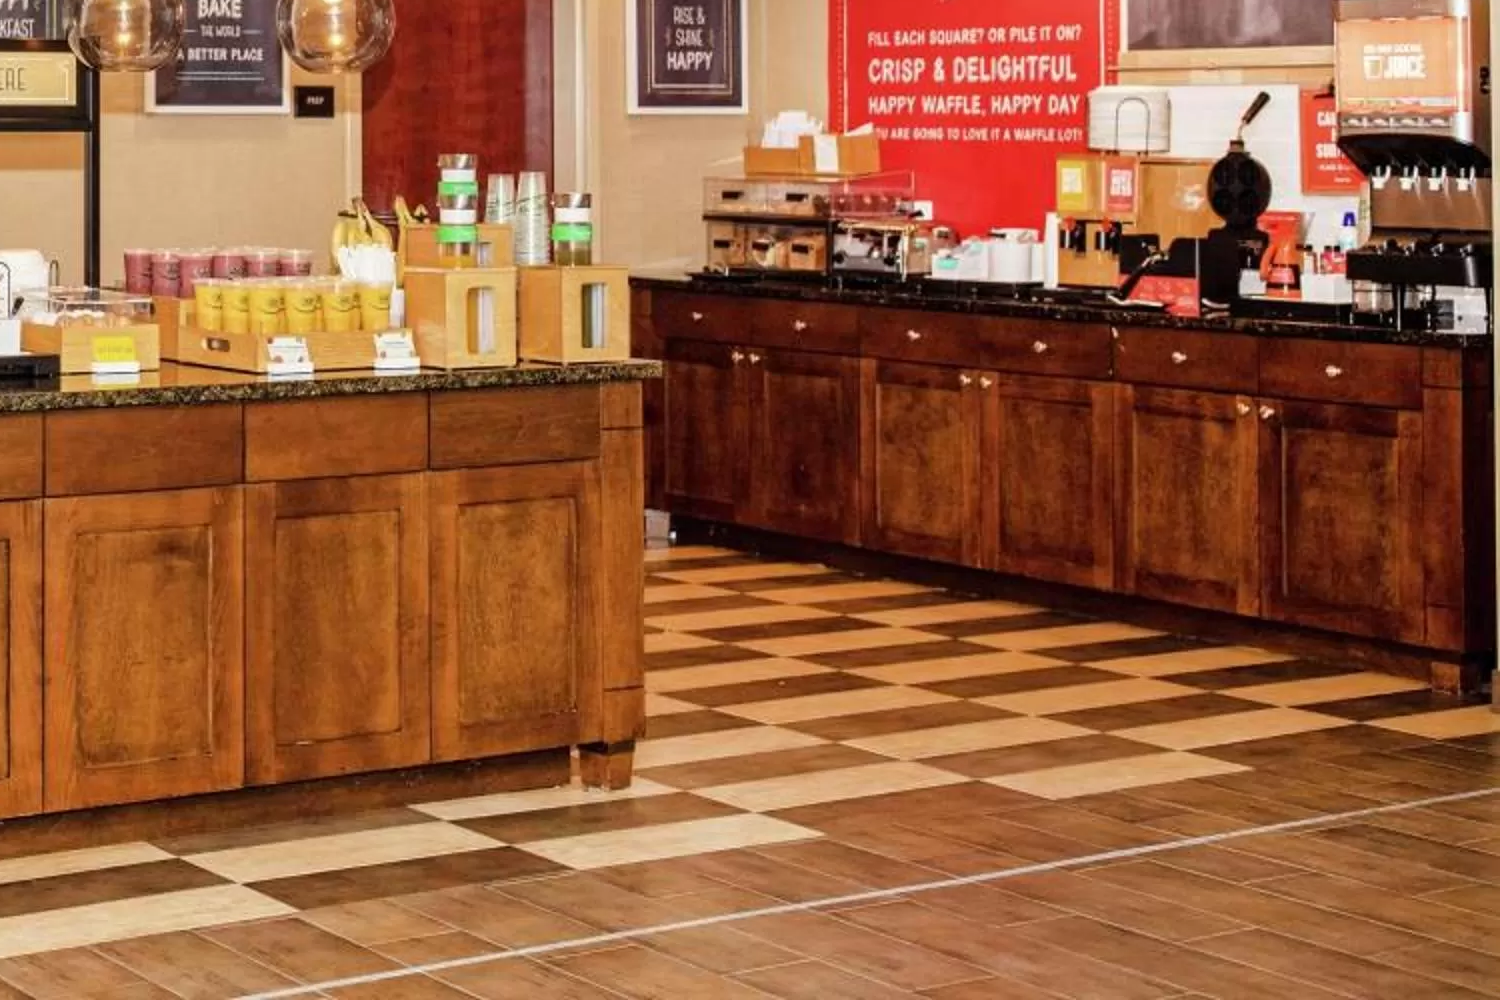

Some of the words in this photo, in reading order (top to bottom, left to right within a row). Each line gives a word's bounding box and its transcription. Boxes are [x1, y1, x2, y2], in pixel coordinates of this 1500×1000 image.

[673, 6, 694, 24] RISE
[696, 5, 705, 25] &
[201, 25, 213, 36] THE
[216, 25, 241, 37] WORLD
[675, 28, 703, 47] SHINE
[868, 31, 890, 46] FILL
[894, 29, 925, 46] EACH
[929, 28, 984, 46] SQUARE?
[988, 26, 1005, 42] OR
[1009, 25, 1036, 42] PILE
[1040, 25, 1051, 41] IT
[1056, 24, 1081, 41] ON?
[176, 48, 185, 61] A
[188, 48, 227, 60] BETTER
[231, 48, 264, 61] PLACE
[667, 52, 713, 71] HAPPY
[868, 56, 926, 84] CRISP
[933, 56, 945, 83] &
[953, 54, 1077, 82] DELIGHTFUL
[1384, 55, 1428, 80] JUICE
[868, 96, 915, 115] HAPPY
[922, 95, 986, 116] WAFFLE,
[991, 95, 1043, 115] HAPPY
[1048, 94, 1080, 115] DAY
[891, 127, 910, 140] ARE
[913, 127, 944, 140] GOING
[947, 127, 960, 140] TO
[963, 127, 988, 141] LOVE
[991, 127, 1000, 141] IT
[1004, 128, 1011, 141] A
[1014, 127, 1055, 141] WAFFLE
